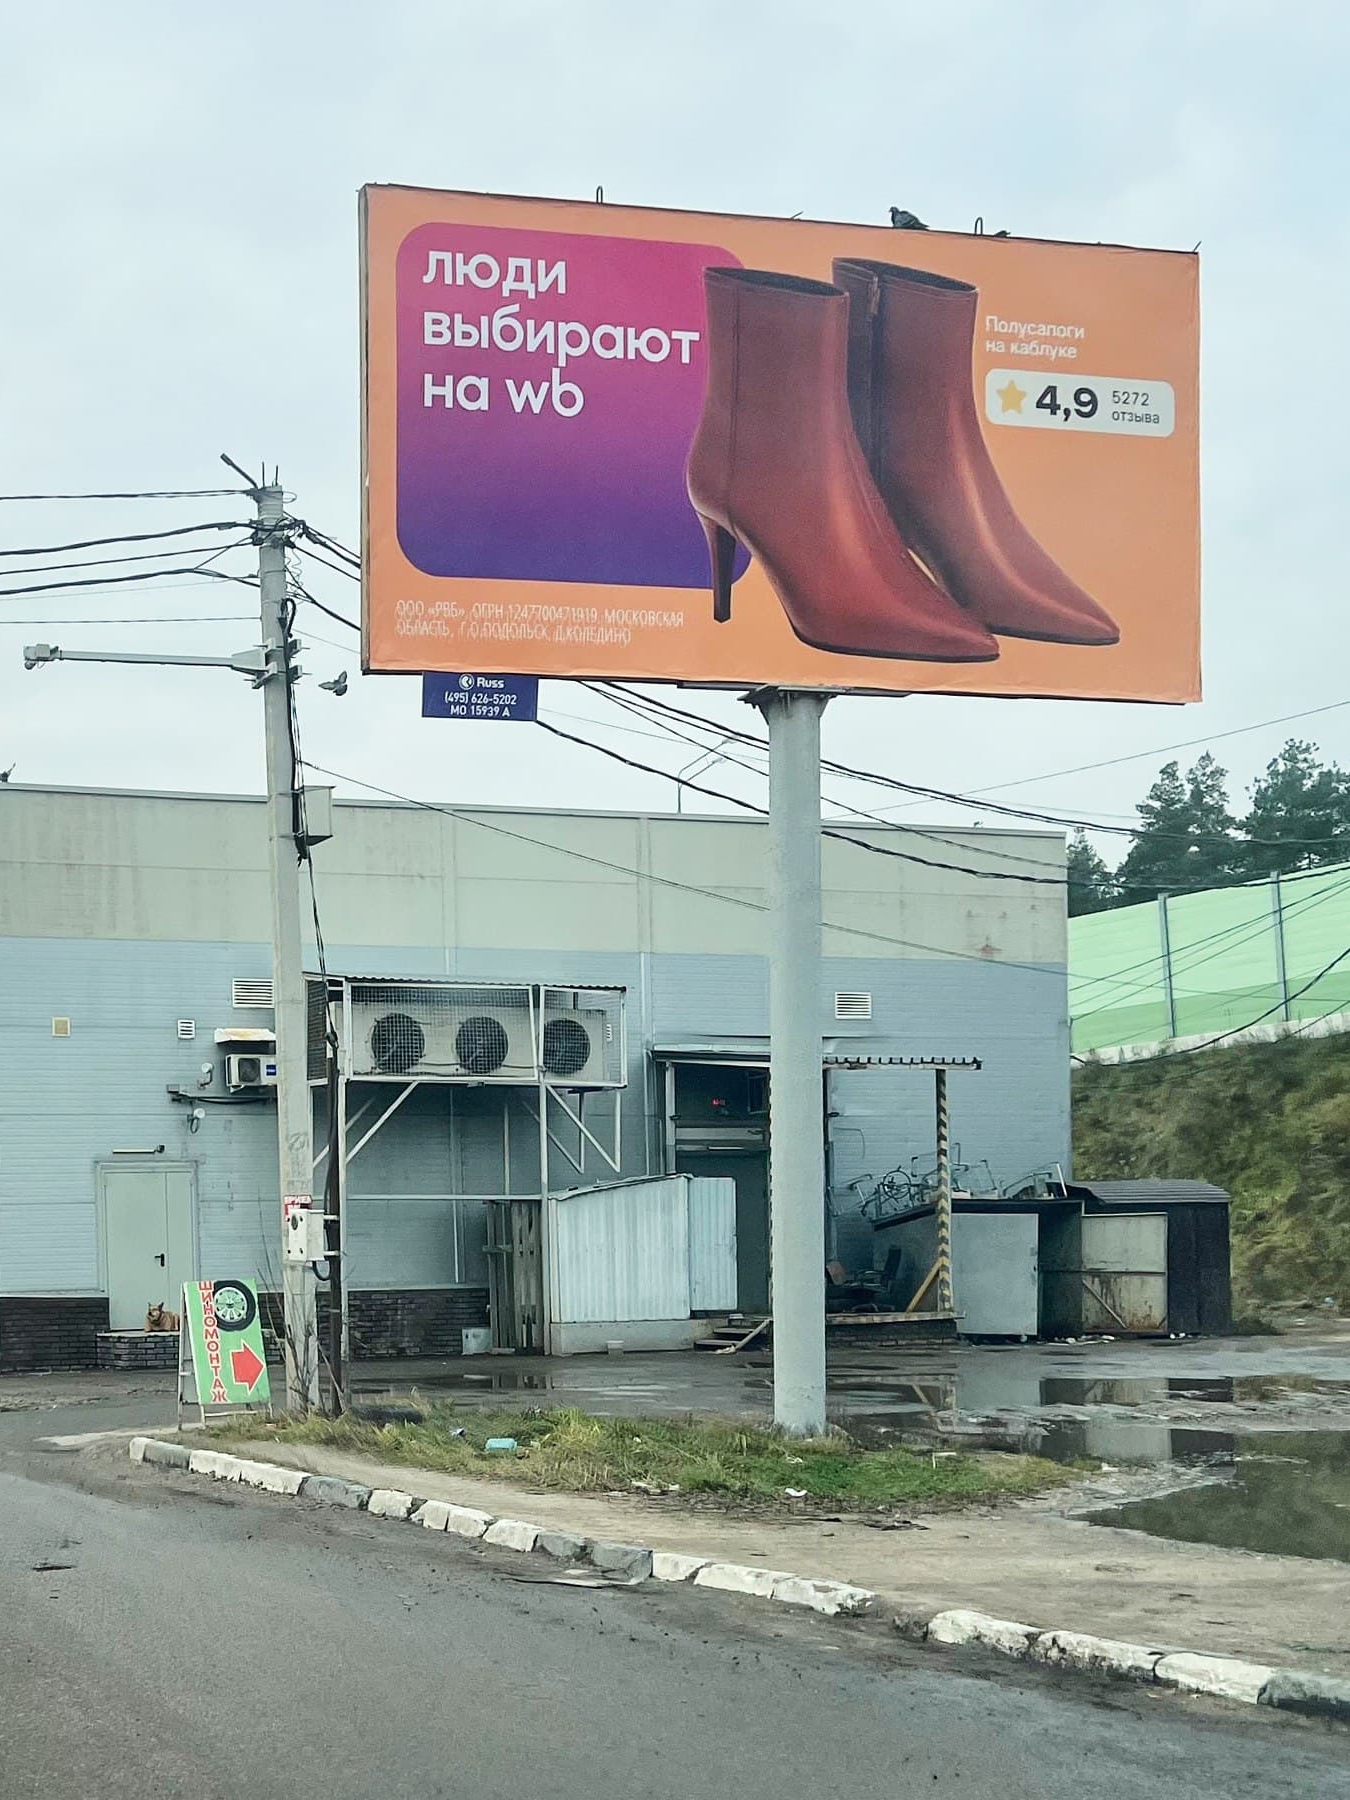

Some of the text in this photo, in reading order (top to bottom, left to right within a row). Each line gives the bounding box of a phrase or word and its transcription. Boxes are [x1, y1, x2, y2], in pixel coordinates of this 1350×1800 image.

[422, 250, 567, 299] люди
[423, 303, 700, 366] выбирают
[985, 315, 1085, 339] Полусапоги
[985, 340, 1078, 361] на каблуке
[423, 367, 584, 417] на wb
[1035, 385, 1099, 422] 4,9
[1112, 390, 1150, 406] 5272
[1111, 410, 1160, 424] отзыва
[396, 599, 425, 618] ООО
[472, 602, 504, 618] ОГРН
[604, 607, 684, 626] МОСКОВСКАЯ
[476, 677, 505, 688] Russ
[444, 691, 517, 705] (495) 626-5202
[470, 705, 500, 717] 15939
[200, 1281, 227, 1402] ШИНОМОНТАЖ
